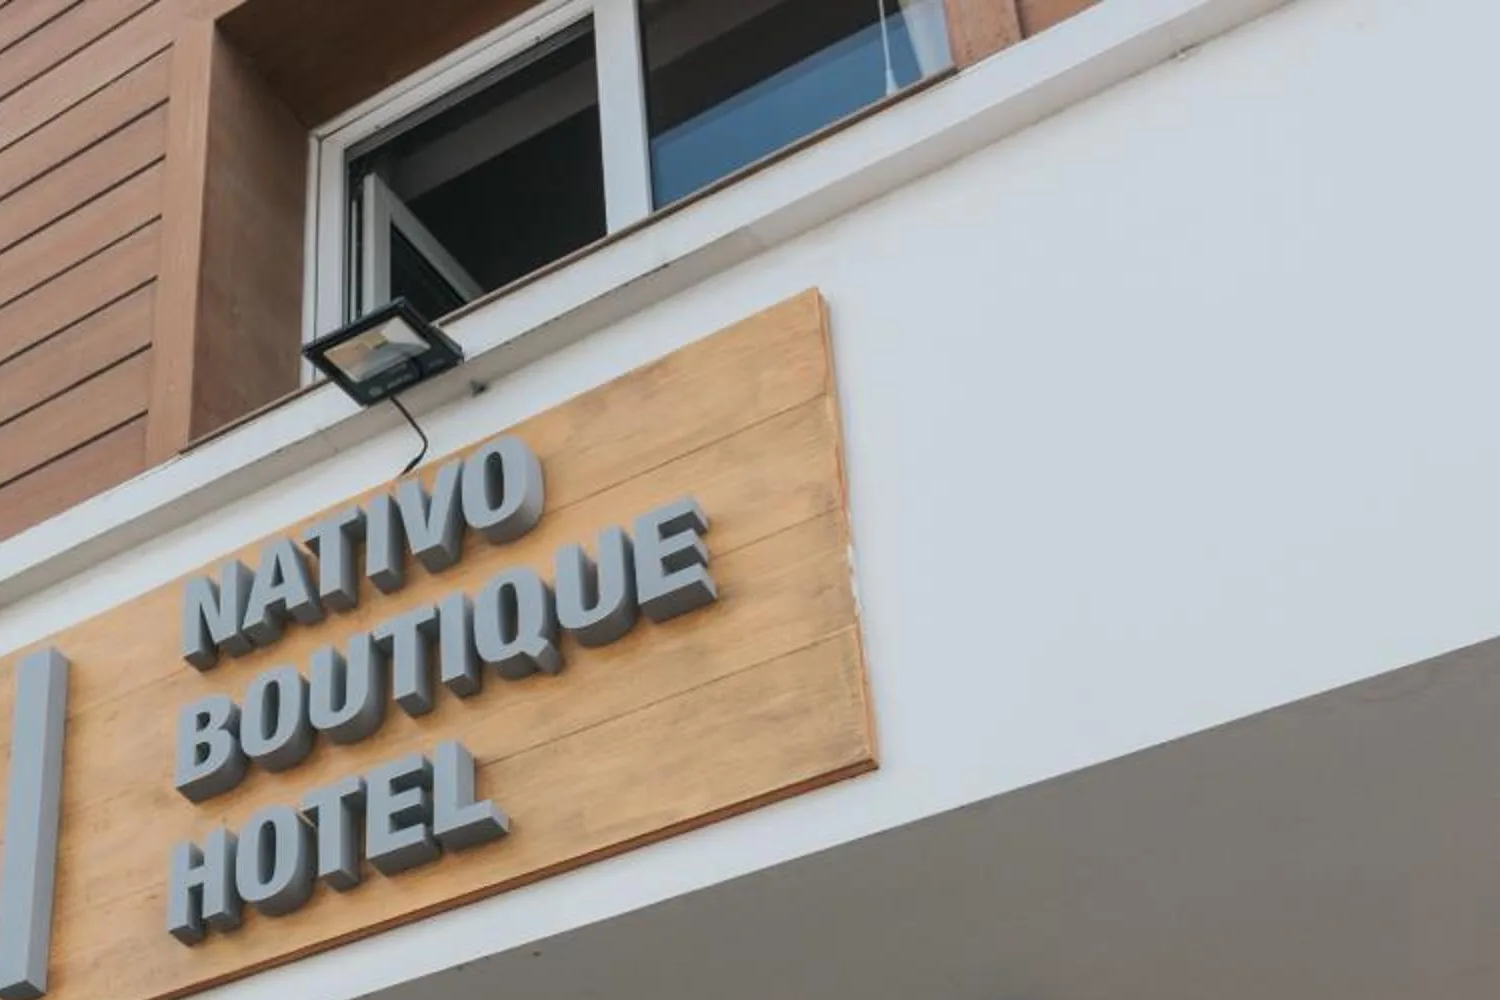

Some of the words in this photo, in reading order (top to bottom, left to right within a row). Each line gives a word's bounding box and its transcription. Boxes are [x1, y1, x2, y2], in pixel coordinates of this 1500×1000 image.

[175, 493, 717, 803] BOUTIQUE
[182, 435, 544, 671] NATIVO
[168, 740, 509, 946] HOTEL
